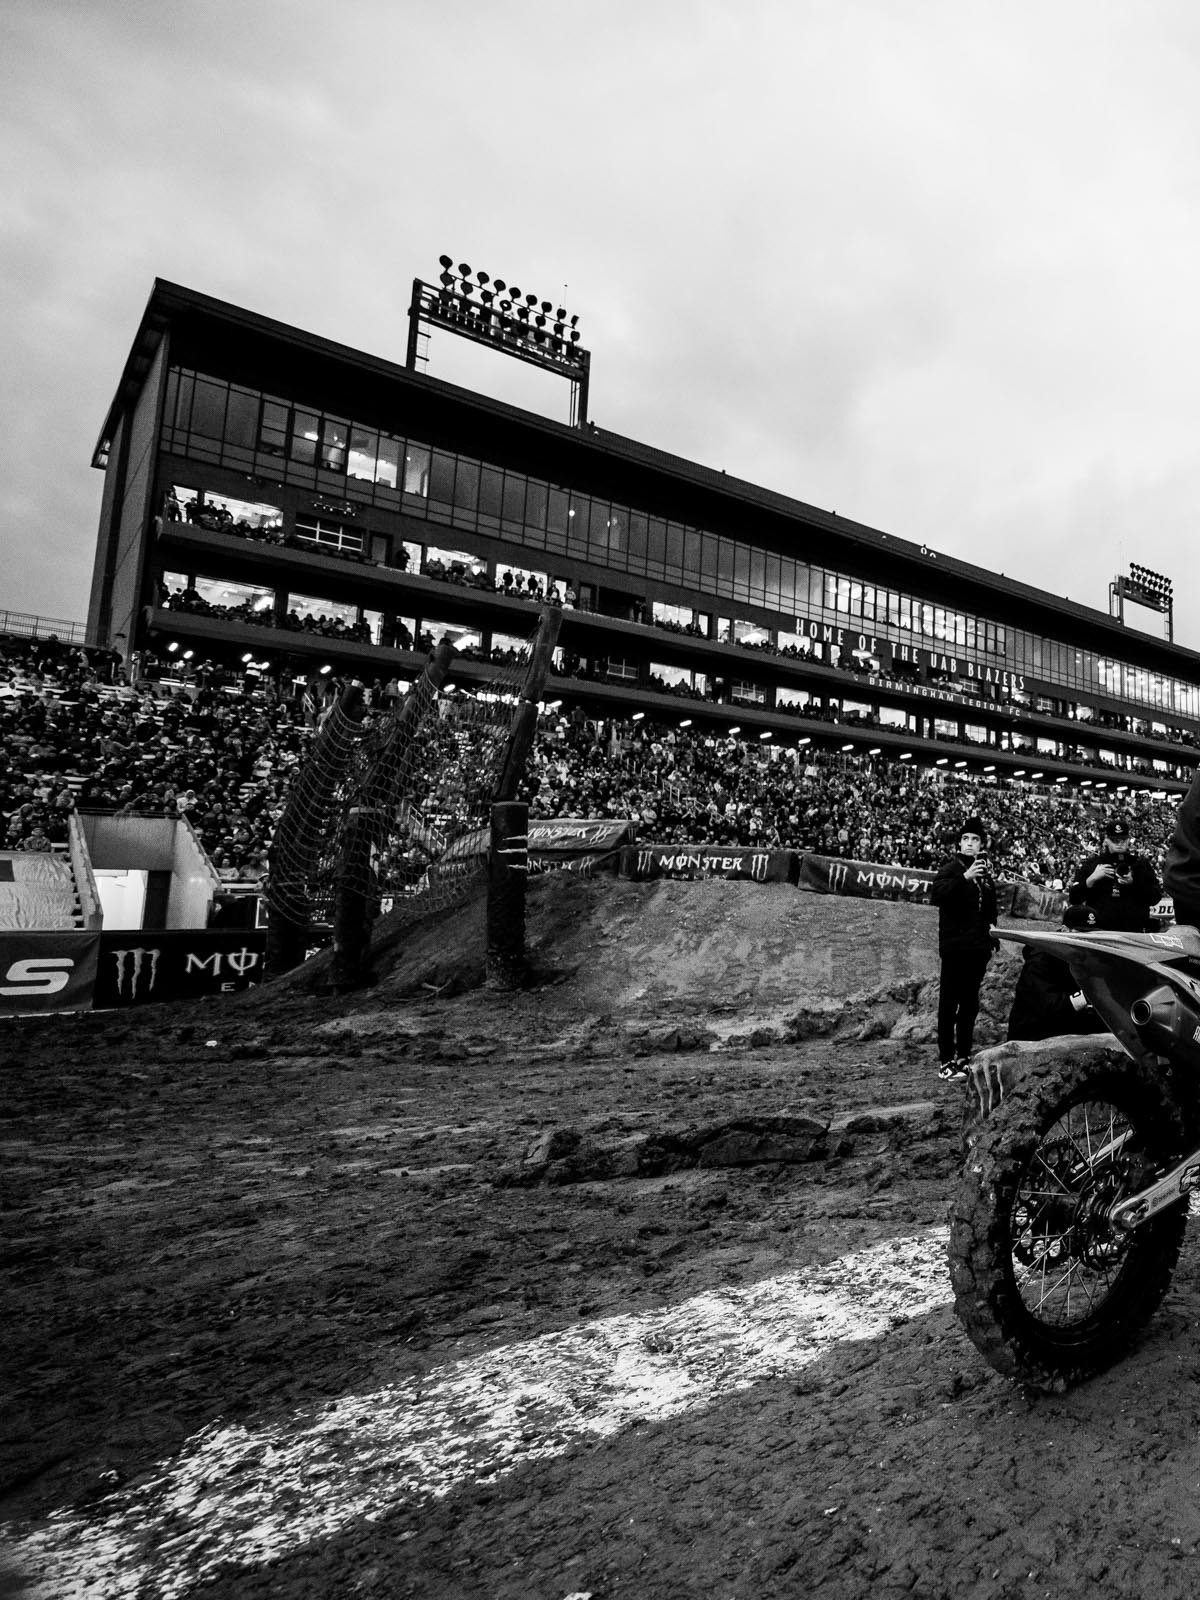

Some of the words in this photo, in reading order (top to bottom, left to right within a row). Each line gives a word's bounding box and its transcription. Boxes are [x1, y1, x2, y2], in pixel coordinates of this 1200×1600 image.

[796, 618, 844, 646] HOME
[858, 634, 877, 653] OF
[891, 642, 918, 664] THE
[931, 653, 957, 673] UAB
[968, 662, 1024, 690] BLAZERS
[869, 677, 954, 702] BIRMINGHAM
[962, 697, 1002, 713] LEGION
[1009, 708, 1020, 717] FC
[659, 852, 743, 871] MONSTER
[857, 871, 934, 893] MONST
[184, 947, 266, 976] MO
